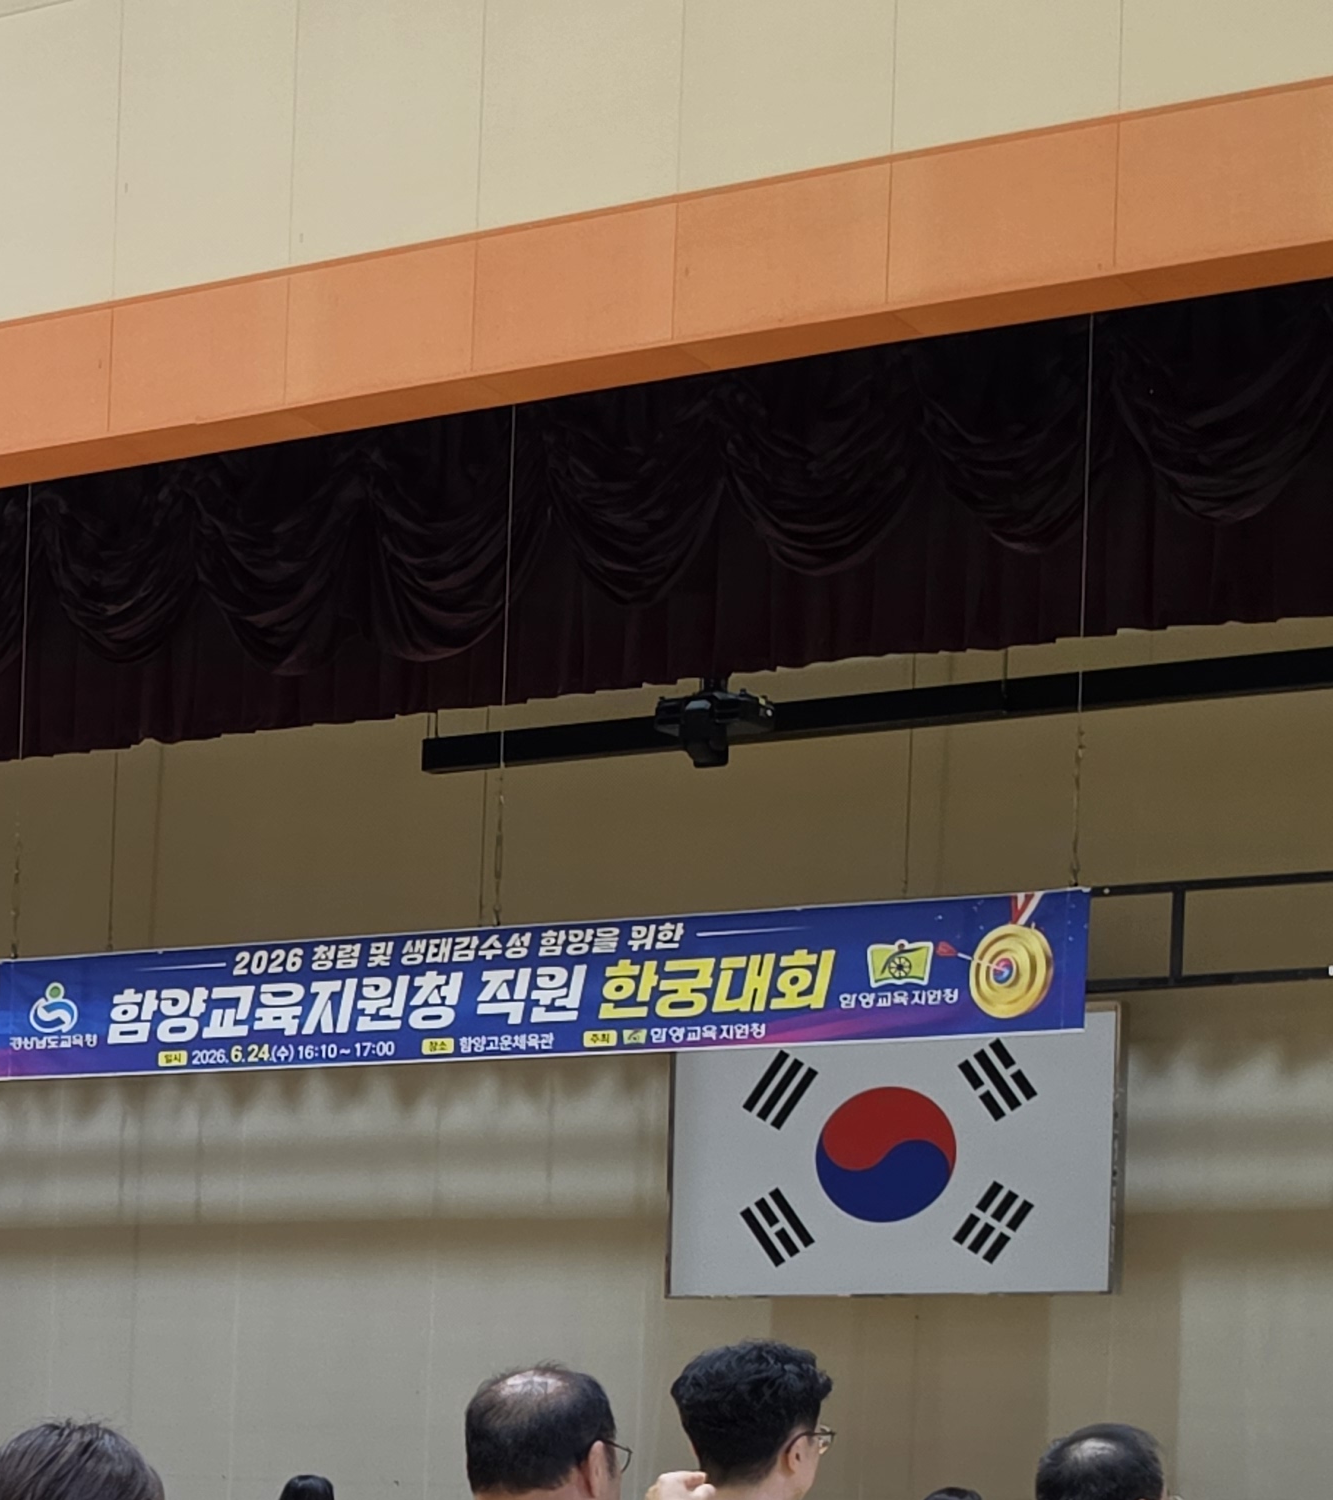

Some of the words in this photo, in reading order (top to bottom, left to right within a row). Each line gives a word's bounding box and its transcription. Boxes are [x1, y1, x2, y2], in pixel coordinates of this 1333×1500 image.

[233, 948, 304, 975] 2026
[311, 943, 361, 971] 청렴
[367, 941, 395, 967] 및
[401, 932, 532, 966] 생태감수성
[538, 927, 620, 957] 함양을
[628, 922, 684, 951] 위한
[107, 971, 464, 1044] 함양교육지원청
[477, 963, 588, 1025] 직원
[598, 949, 836, 1019] 한궁대회
[9, 1033, 98, 1051] 경상남도교육청
